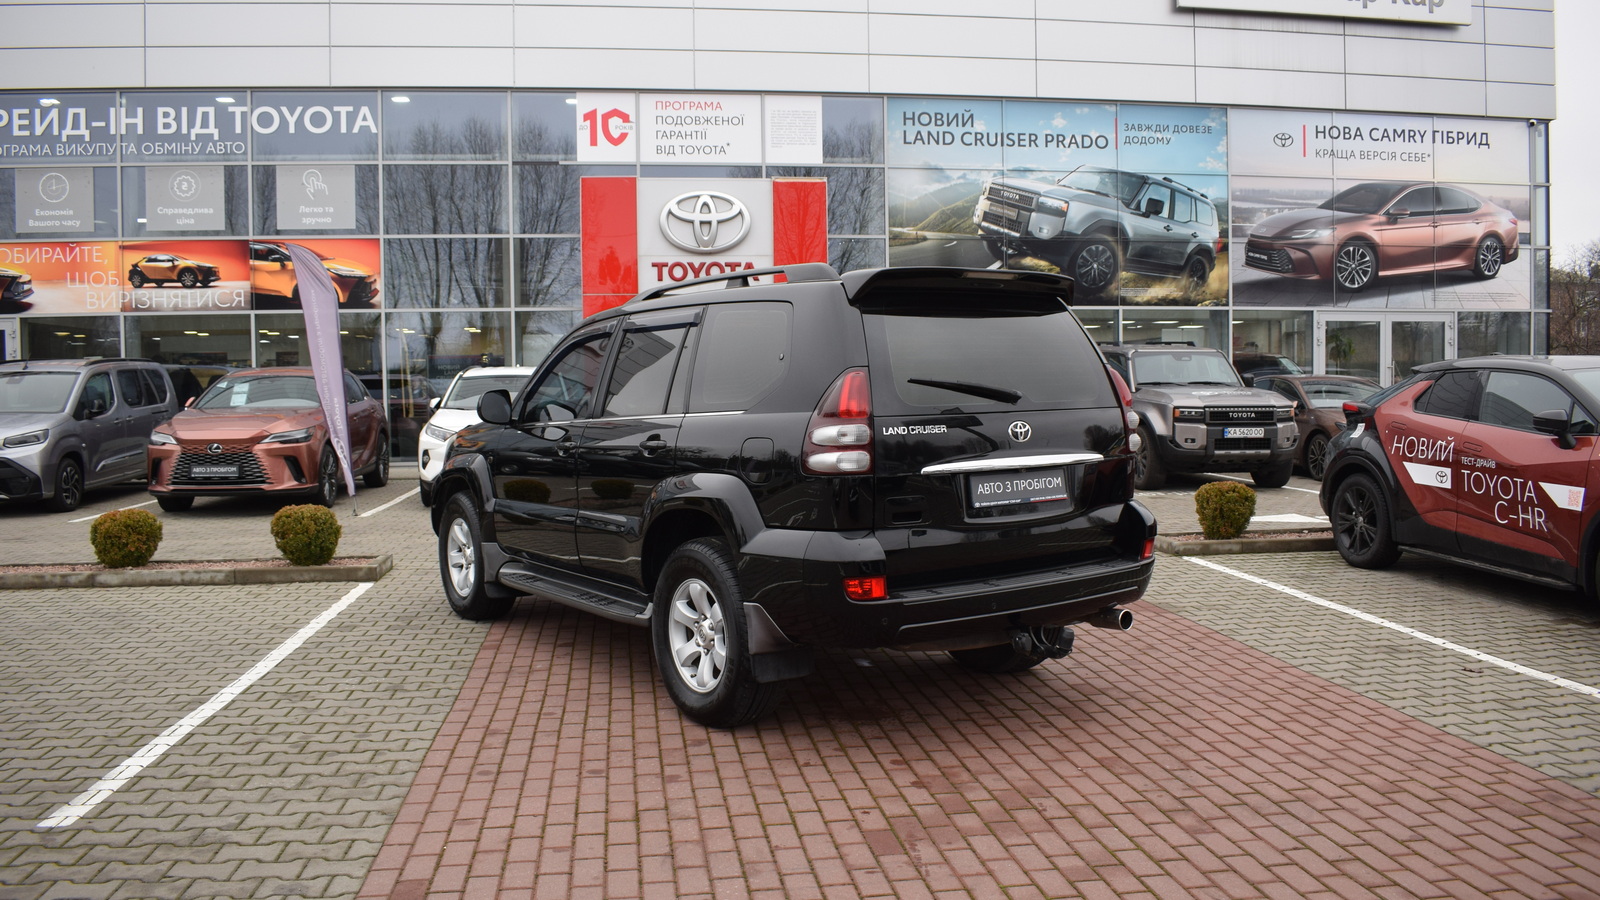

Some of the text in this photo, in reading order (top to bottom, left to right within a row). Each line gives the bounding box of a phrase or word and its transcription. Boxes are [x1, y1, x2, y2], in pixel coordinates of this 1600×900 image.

[655, 100, 723, 111] ПРОГРАМА
[156, 106, 219, 140] ВІД
[228, 105, 378, 134] TOYOTA
[655, 114, 745, 127] ПОДОВЖЕНОЇ
[903, 109, 974, 128] НОВИЙ
[655, 128, 708, 140] ГАРАНТІЇ
[1123, 123, 1212, 134] ЗАВЖДИ ДОВЕЗЕ
[903, 130, 1109, 149] LAND CRUISER PRADO
[1124, 136, 1171, 146] ДОДОМУ
[1315, 125, 1490, 149] НОВА CAMRY ГІБРИД
[0, 142, 246, 156] ГРАМА ВИКУПУ ТА ОБМІНУ АВТО
[656, 145, 676, 156] ВІД
[1315, 148, 1356, 161] КРАЩА
[1360, 150, 1397, 161] ВЕРСІЯ
[157, 206, 214, 215] Справедлива
[299, 206, 324, 214] Легко
[176, 217, 194, 225] ціна
[67, 271, 119, 290] ЩОБ
[86, 288, 245, 309] ВИРІЗНЯТИСЯ
[883, 425, 947, 436] LAND CRUISER
[1391, 435, 1455, 462] НОВИЙ
[1461, 456, 1496, 468] ТЕСТ-ДРАЙВ
[978, 482, 1003, 494] АВТО
[1013, 476, 1062, 491] ПРОБІГОМ
[1461, 470, 1538, 504] TOYOTA
[1494, 501, 1548, 532] C-HR
